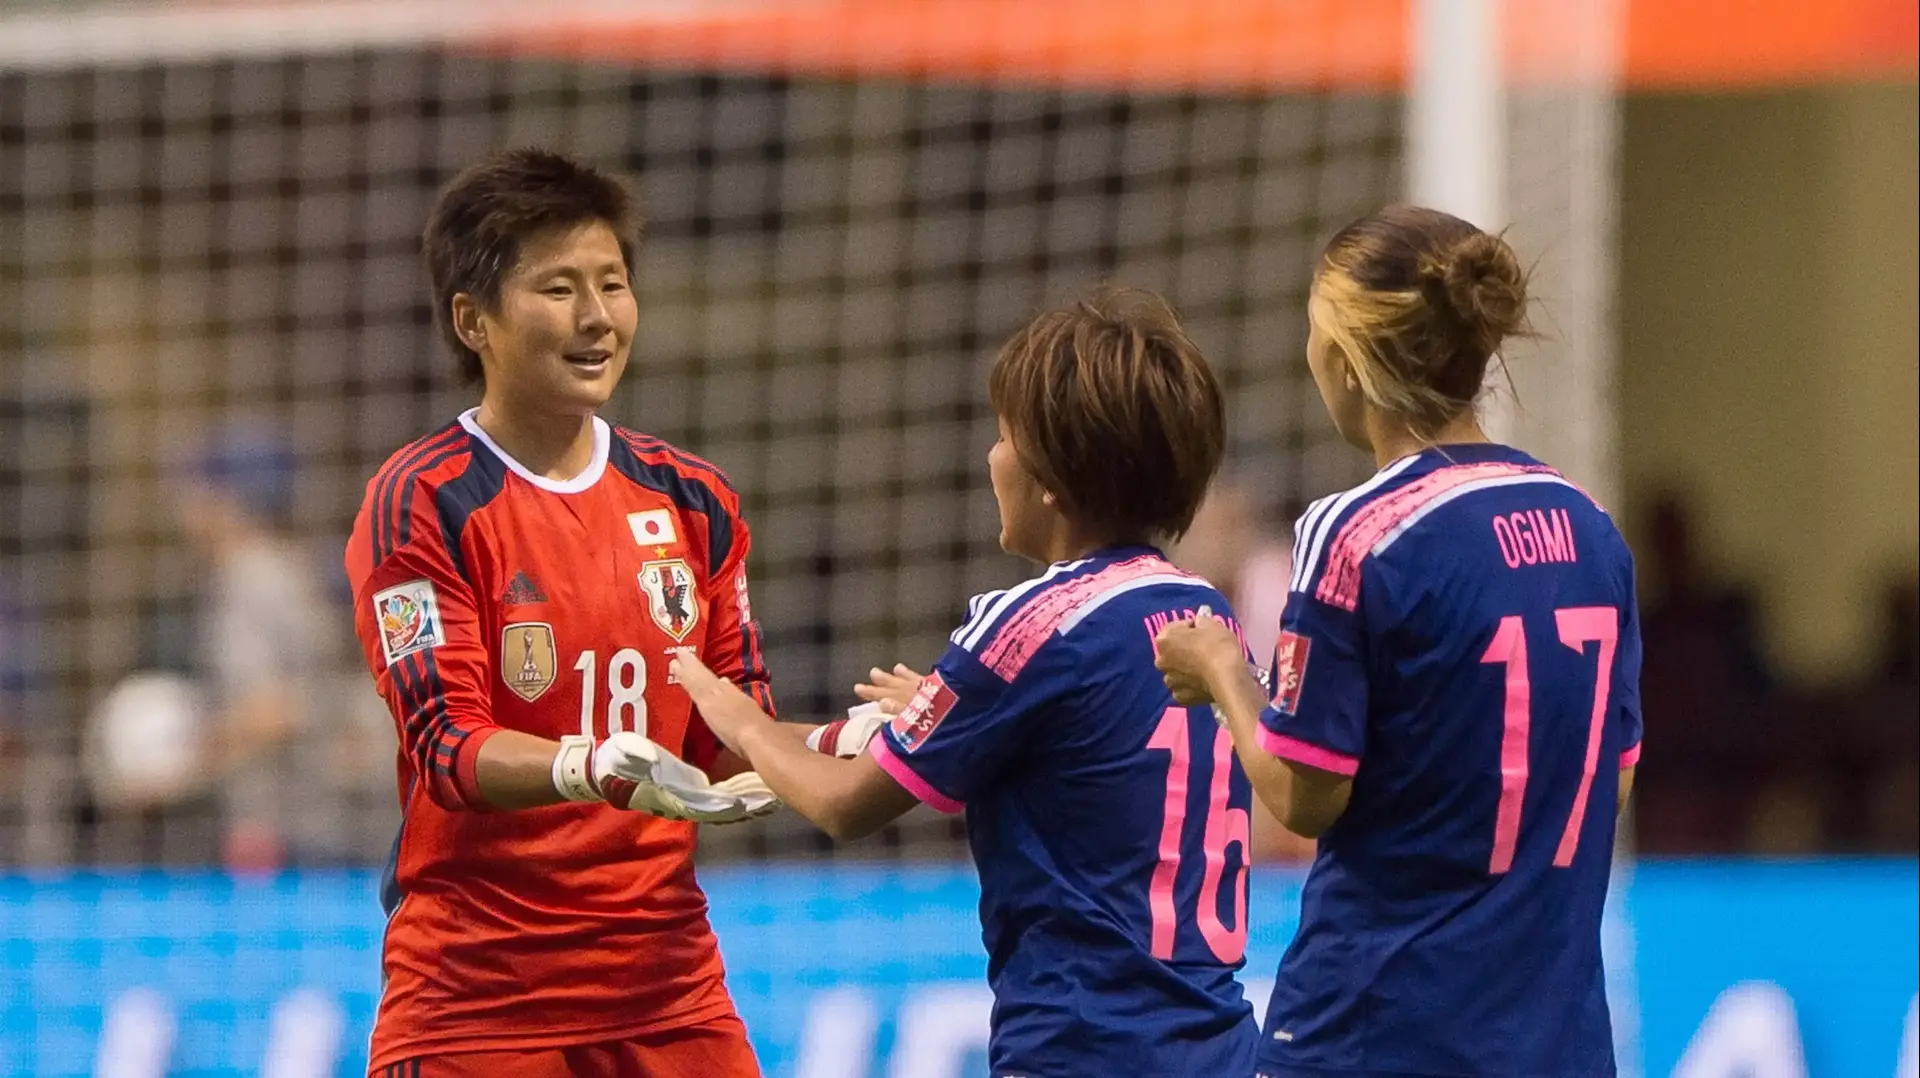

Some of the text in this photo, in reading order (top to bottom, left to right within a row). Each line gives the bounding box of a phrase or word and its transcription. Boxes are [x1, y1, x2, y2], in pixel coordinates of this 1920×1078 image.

[1492, 508, 1577, 569] OGIMI
[518, 671, 541, 681] FIFA
[573, 648, 649, 737] 18
[1480, 606, 1618, 875] 17
[1146, 706, 1251, 965] 16
